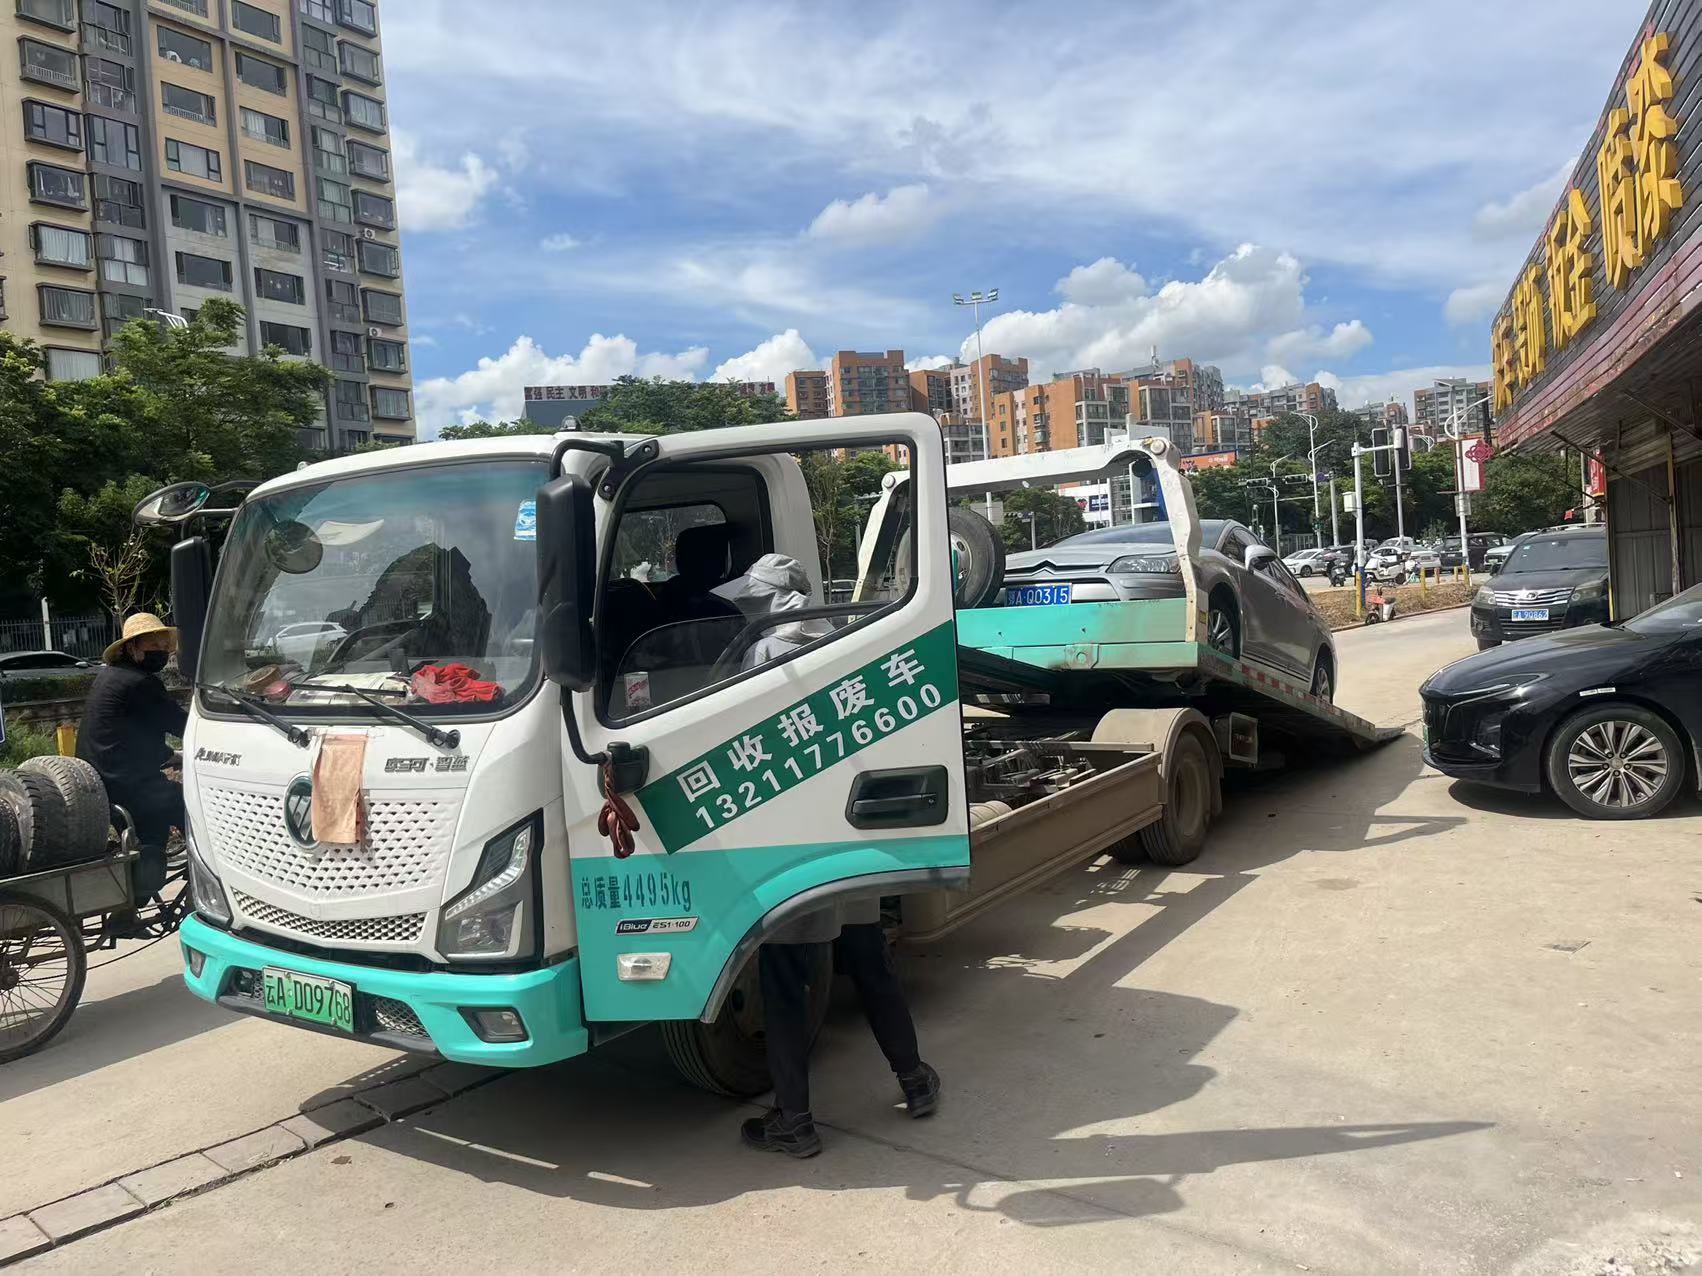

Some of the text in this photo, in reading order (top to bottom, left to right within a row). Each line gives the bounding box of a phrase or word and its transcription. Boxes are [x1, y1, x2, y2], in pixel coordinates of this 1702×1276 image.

[546, 386, 565, 400] 民主
[676, 648, 926, 804] 回收报废车
[695, 683, 942, 830] 13211776600
